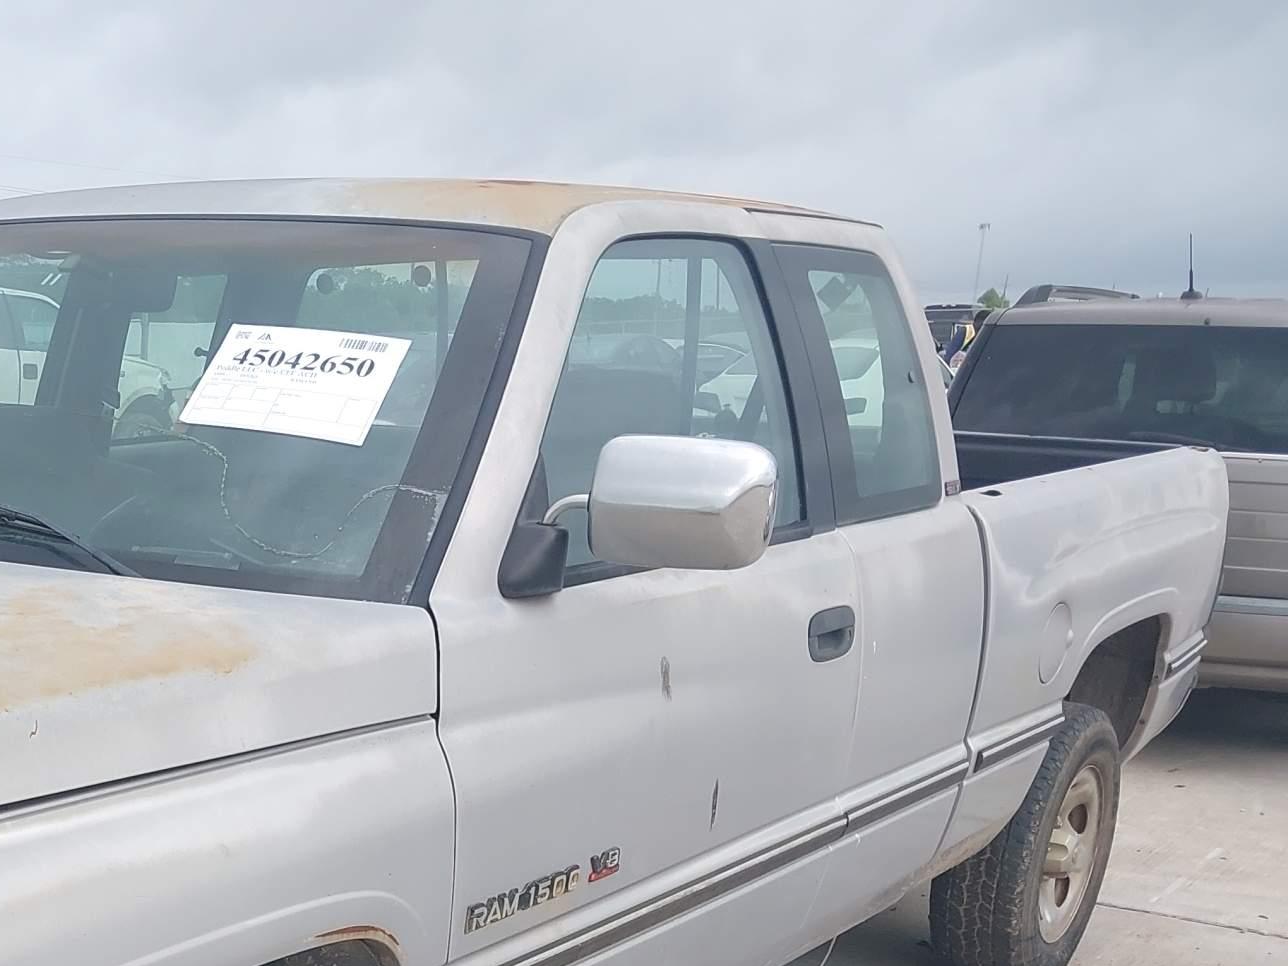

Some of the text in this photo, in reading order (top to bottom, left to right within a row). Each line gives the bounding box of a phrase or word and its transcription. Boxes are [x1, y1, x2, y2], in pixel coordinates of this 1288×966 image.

[232, 347, 375, 378] 45042650
[464, 888, 520, 934] RAM
[589, 846, 621, 878] V8
